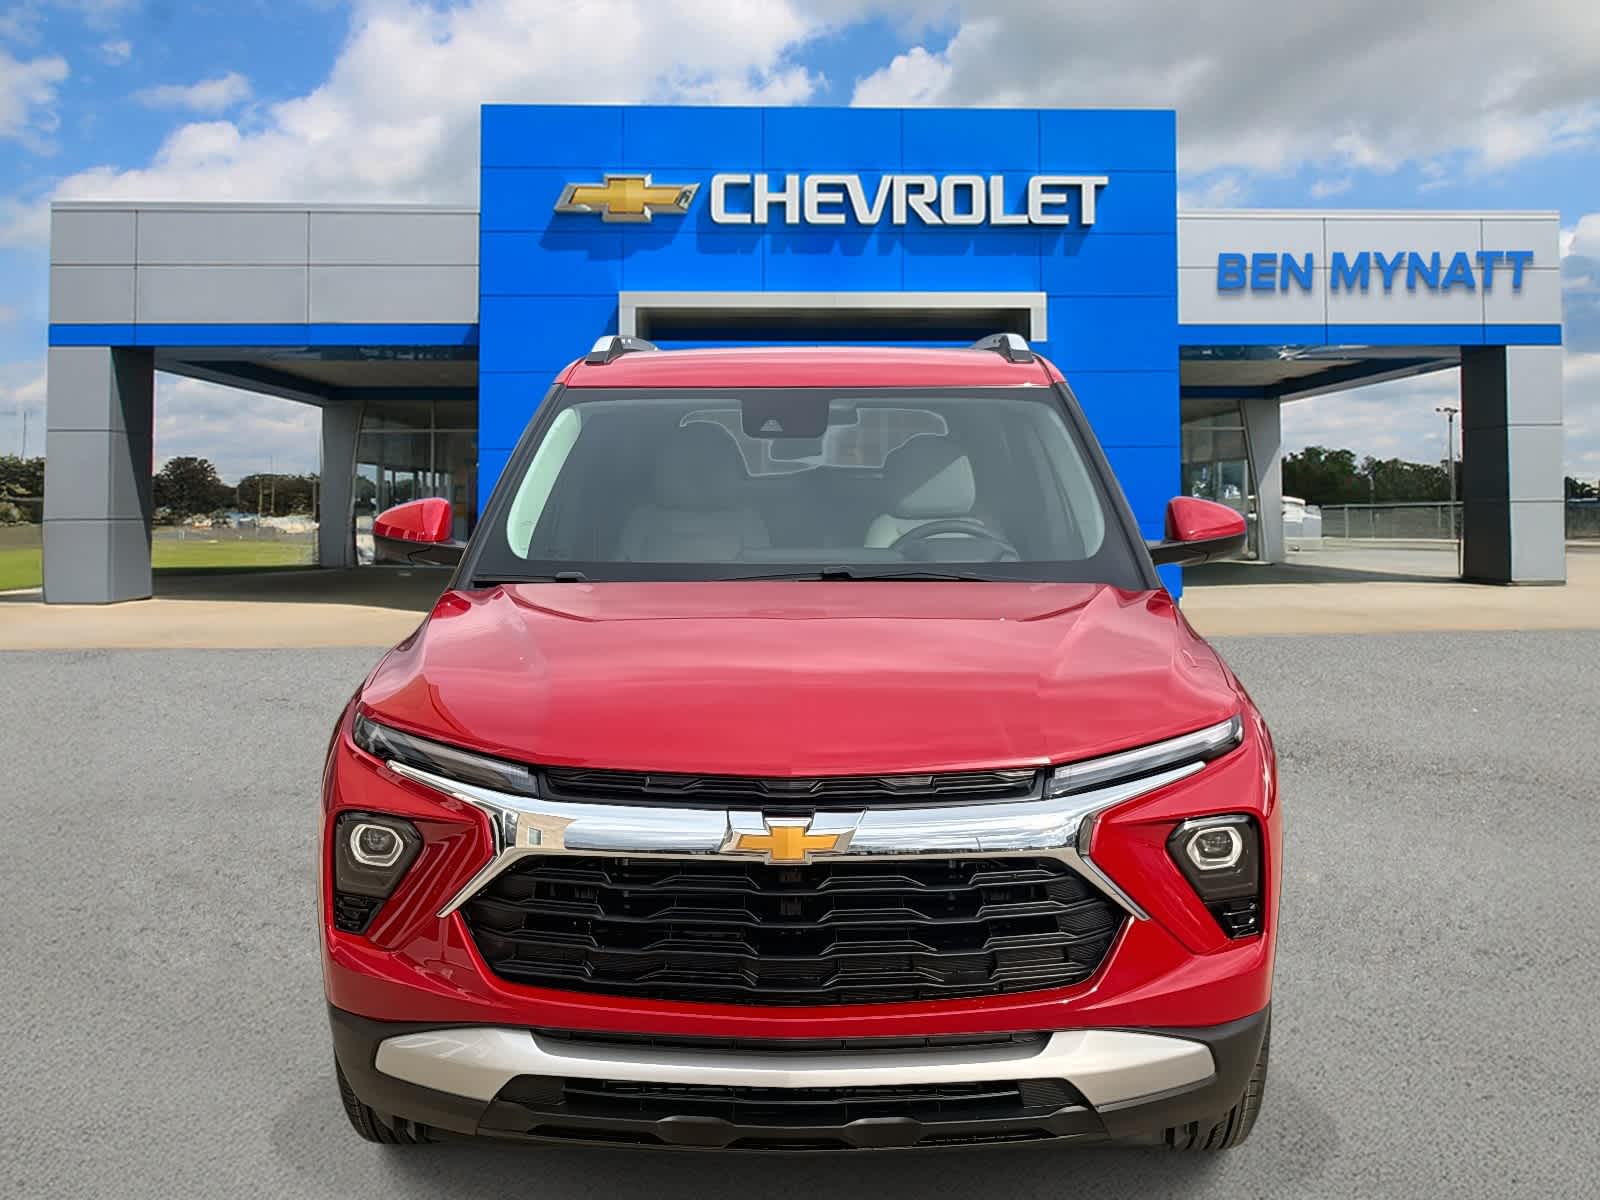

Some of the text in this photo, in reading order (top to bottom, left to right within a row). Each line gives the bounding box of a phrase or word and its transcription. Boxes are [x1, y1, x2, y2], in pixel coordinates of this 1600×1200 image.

[710, 173, 1109, 226] CHEVROLET
[1217, 251, 1534, 291] BEN MYNATT
